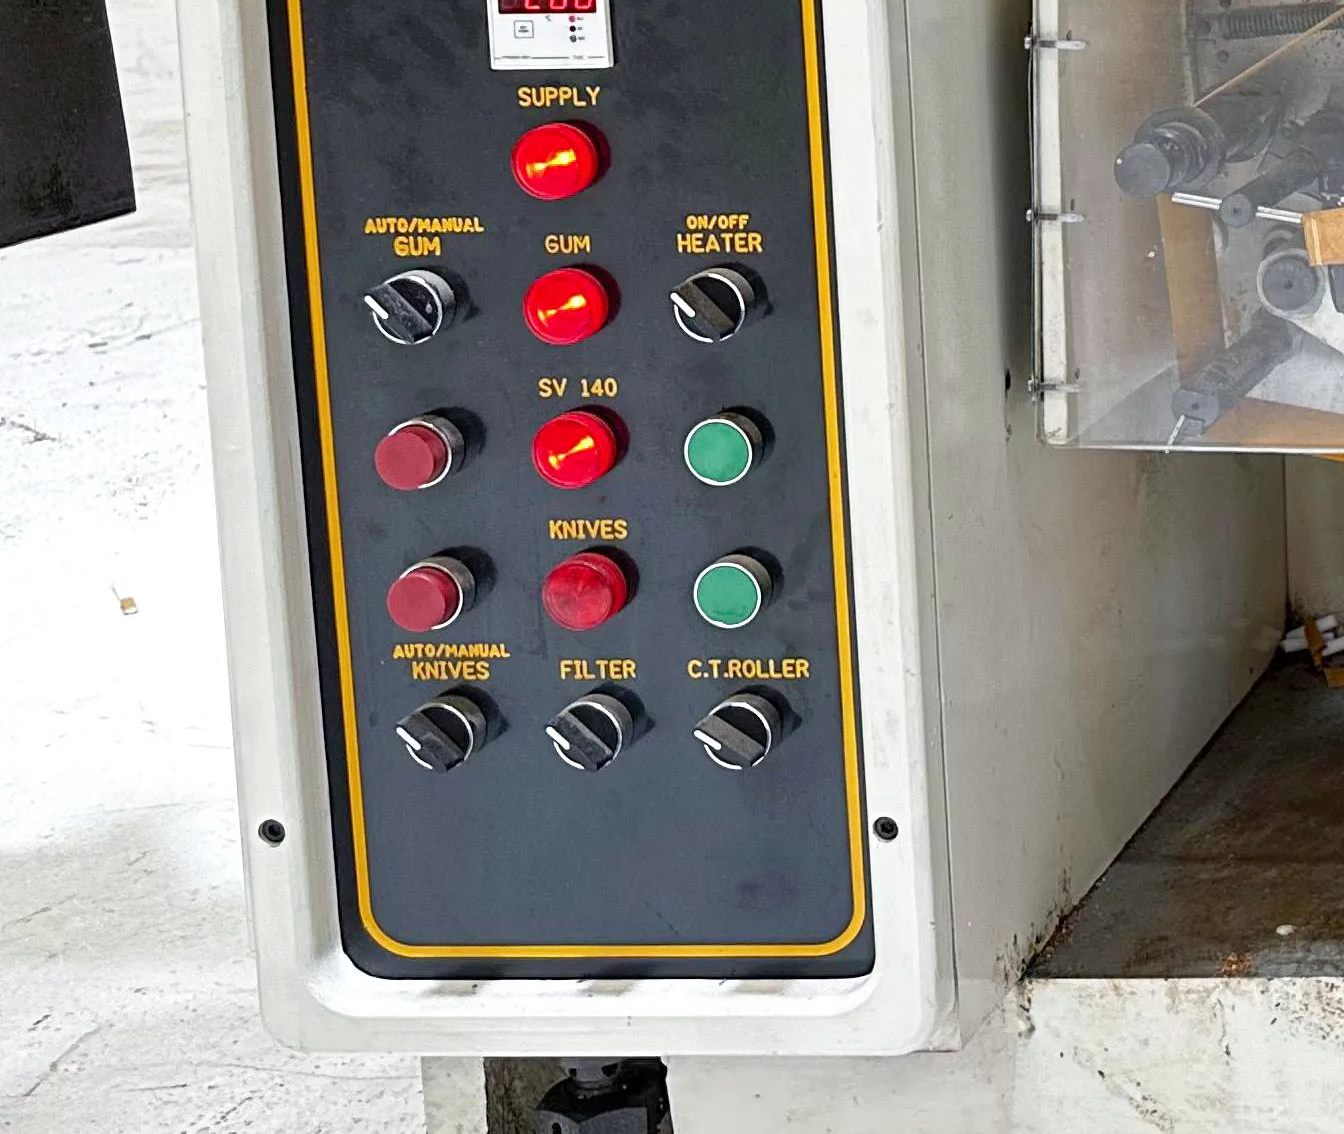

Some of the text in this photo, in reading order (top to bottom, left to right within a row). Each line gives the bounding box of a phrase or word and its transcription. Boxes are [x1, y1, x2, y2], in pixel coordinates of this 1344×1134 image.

[517, 86, 601, 107] SUPPLY
[364, 217, 485, 234] AUTO/MANUAL
[686, 215, 749, 230] ON/OFF
[393, 236, 442, 257] GUM
[544, 234, 591, 254] GUM
[676, 232, 763, 254] HEATER
[538, 377, 618, 398] SV 140
[548, 519, 628, 540] KNIVES
[392, 643, 511, 660] AUTO/MANUAL
[411, 660, 490, 681] KNIVES
[559, 659, 637, 680] FILTER
[687, 658, 810, 679] C.T.ROLLER
